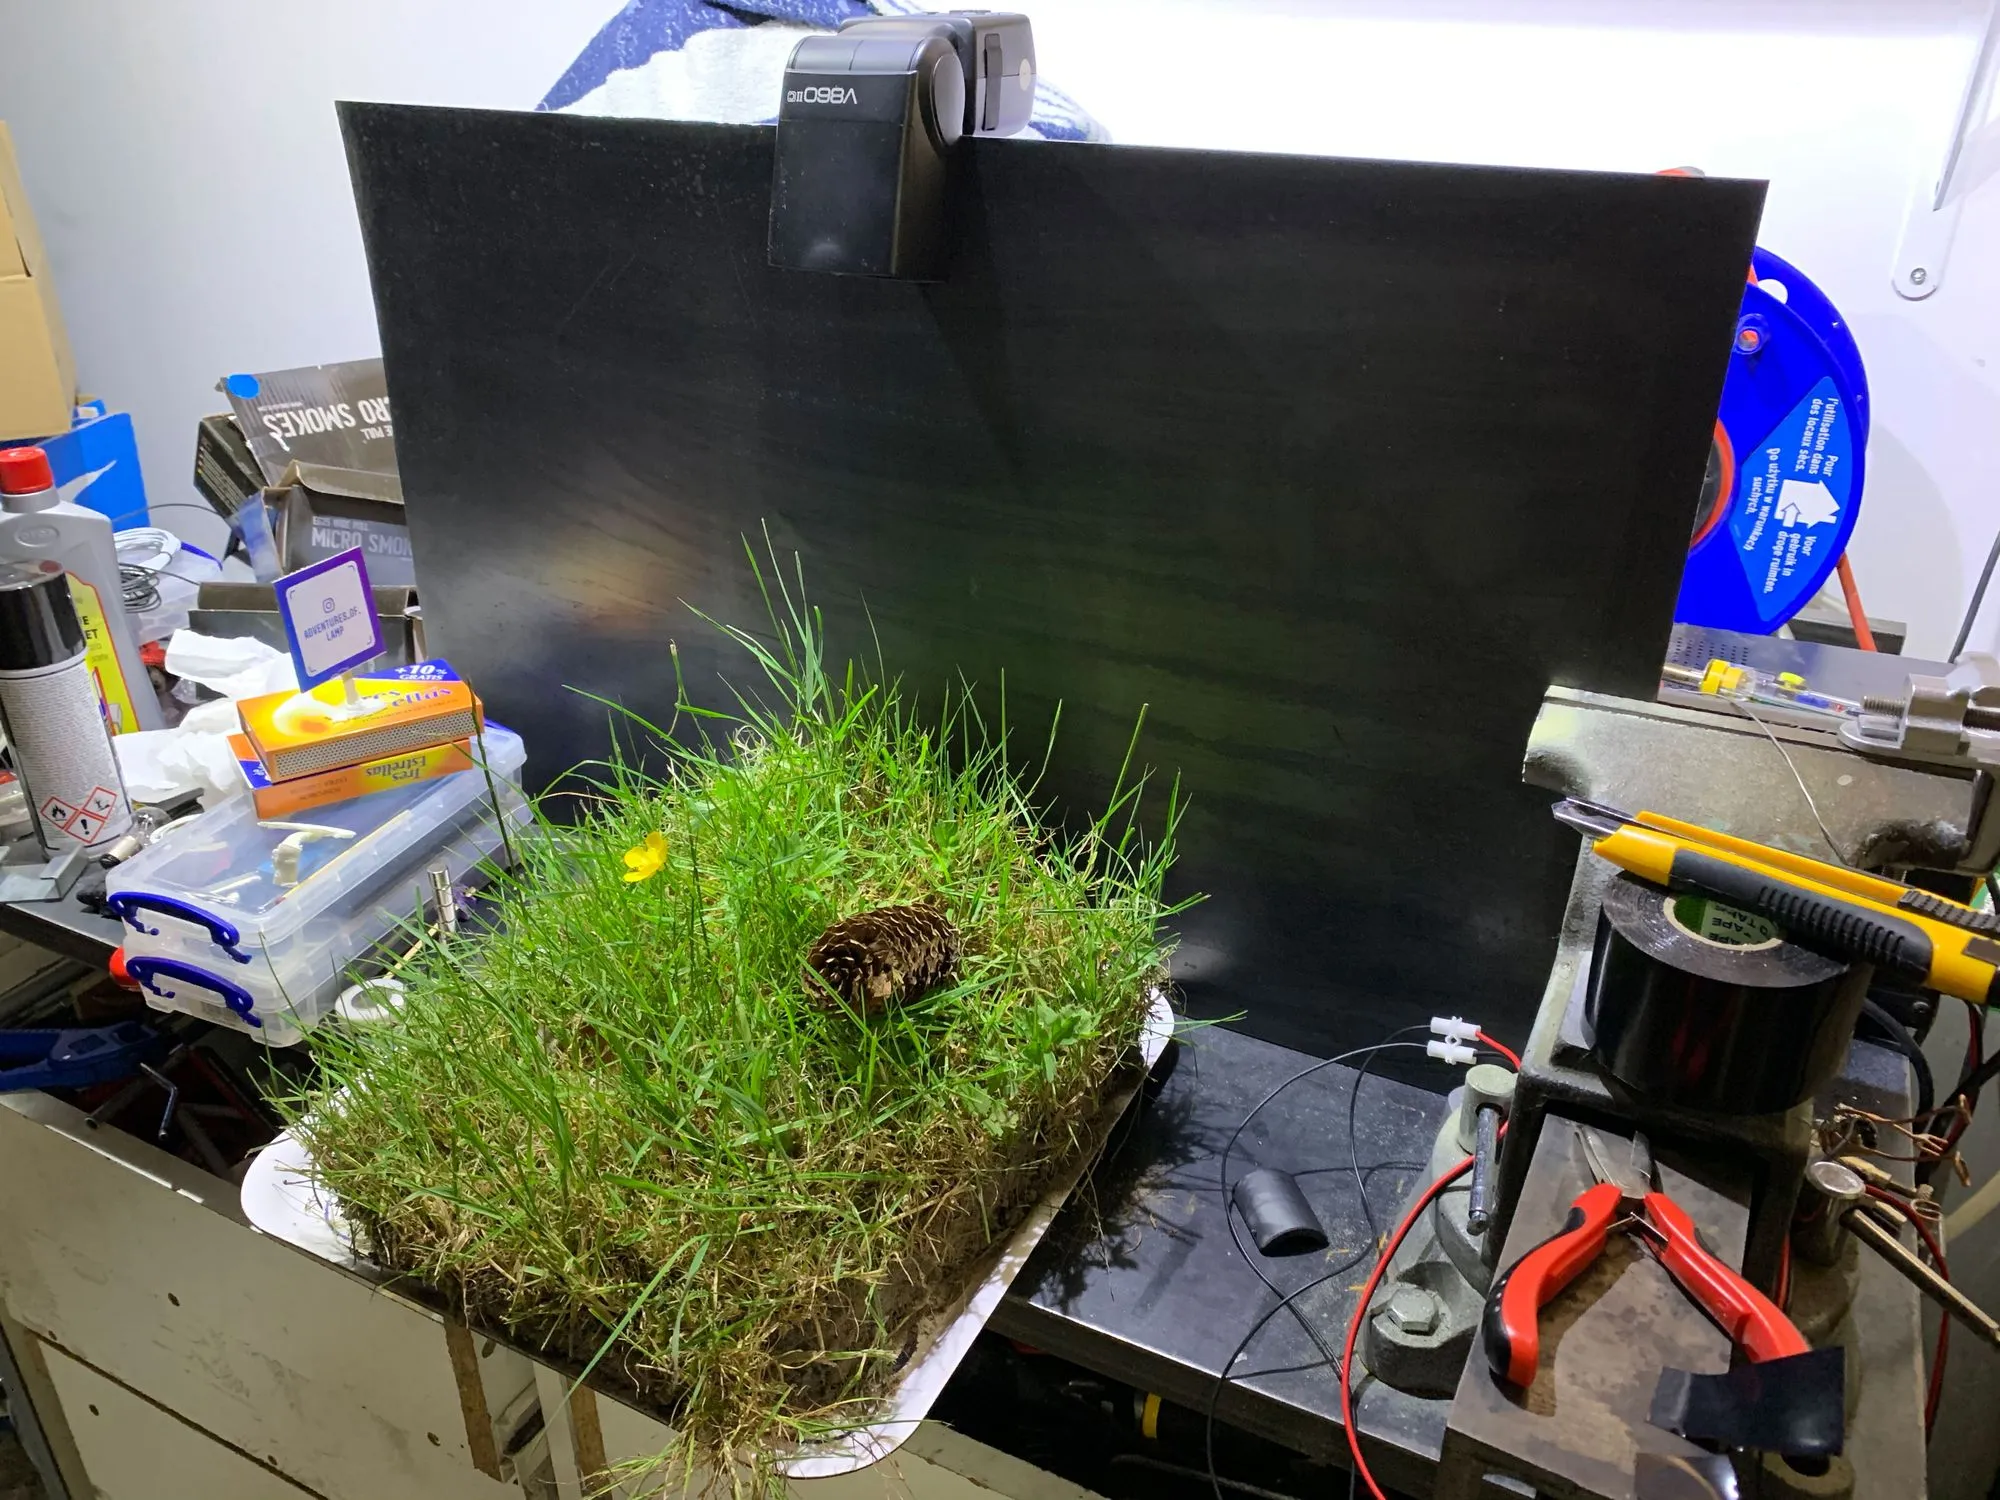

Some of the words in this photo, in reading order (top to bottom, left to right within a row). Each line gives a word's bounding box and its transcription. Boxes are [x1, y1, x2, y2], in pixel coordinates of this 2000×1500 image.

[1809, 398, 1824, 415] des
[262, 402, 357, 438] SMOKES
[1814, 397, 1839, 452] l'utilisation
[1800, 417, 1819, 447] locaux
[1808, 452, 1824, 475] dans
[1823, 455, 1839, 477] Pour
[1745, 476, 1763, 515] suchych.
[1763, 496, 1774, 504] w
[311, 527, 362, 549] MICRO
[1743, 505, 1771, 551] warunkach
[1772, 531, 1790, 556] droge
[1783, 532, 1801, 566] gebruik
[1802, 535, 1817, 556] Voor
[1782, 568, 1795, 577] in
[326, 625, 345, 641] LAMP
[391, 687, 452, 707] ellas
[365, 755, 427, 777] Estrellas
[392, 767, 421, 782] Tres
